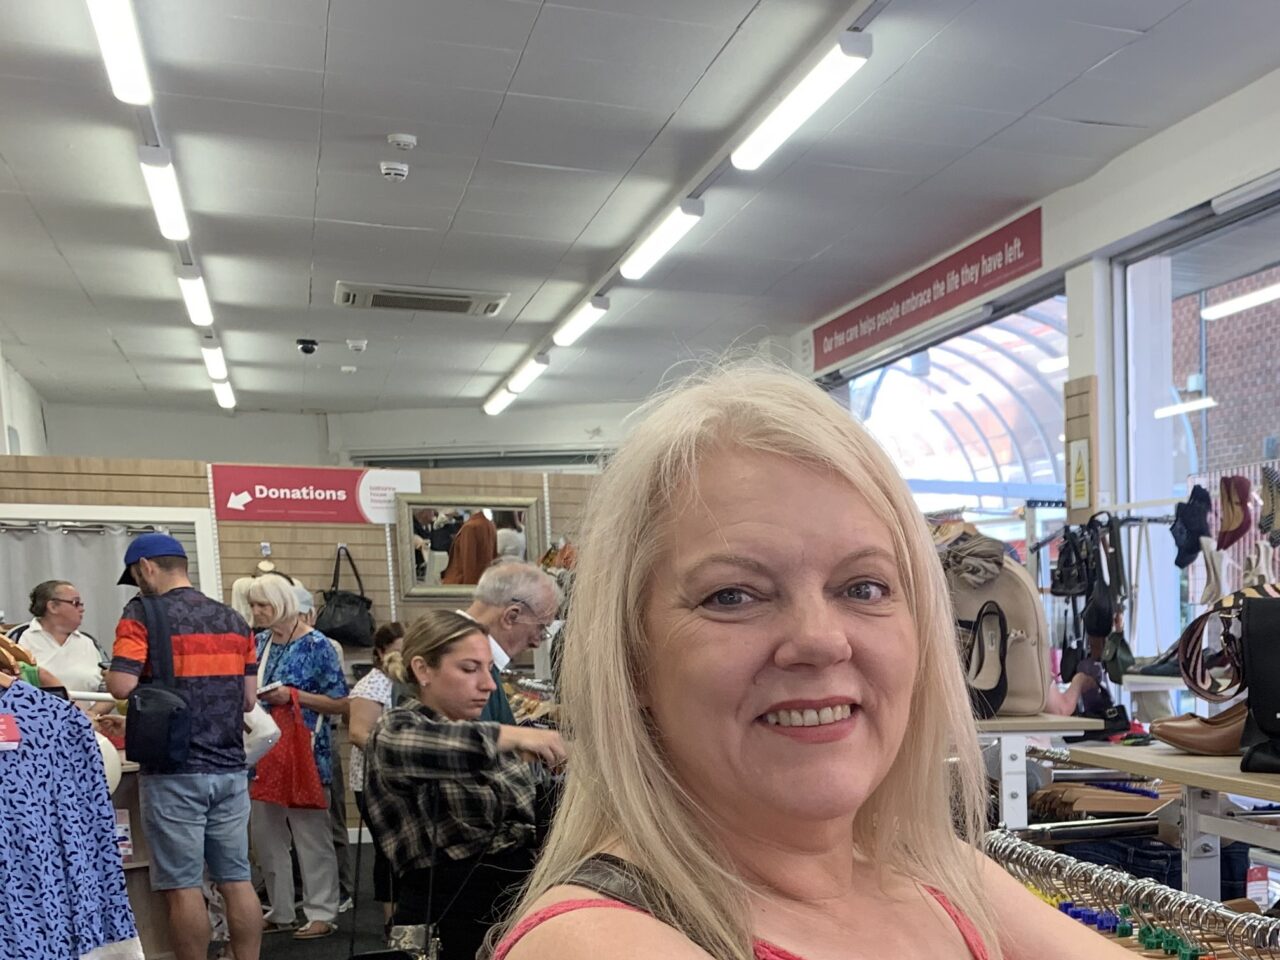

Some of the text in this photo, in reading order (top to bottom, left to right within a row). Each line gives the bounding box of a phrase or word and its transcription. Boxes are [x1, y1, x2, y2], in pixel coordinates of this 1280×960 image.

[823, 336, 833, 354] Our
[834, 330, 845, 349] free
[846, 324, 858, 343] care
[859, 315, 876, 336] helps
[877, 301, 900, 331] people
[901, 288, 931, 316] embrace
[932, 278, 945, 301] the
[946, 269, 959, 294] life
[961, 262, 980, 286] they
[981, 253, 1003, 277] have
[1004, 236, 1024, 266] left.
[254, 484, 347, 502] Donations
